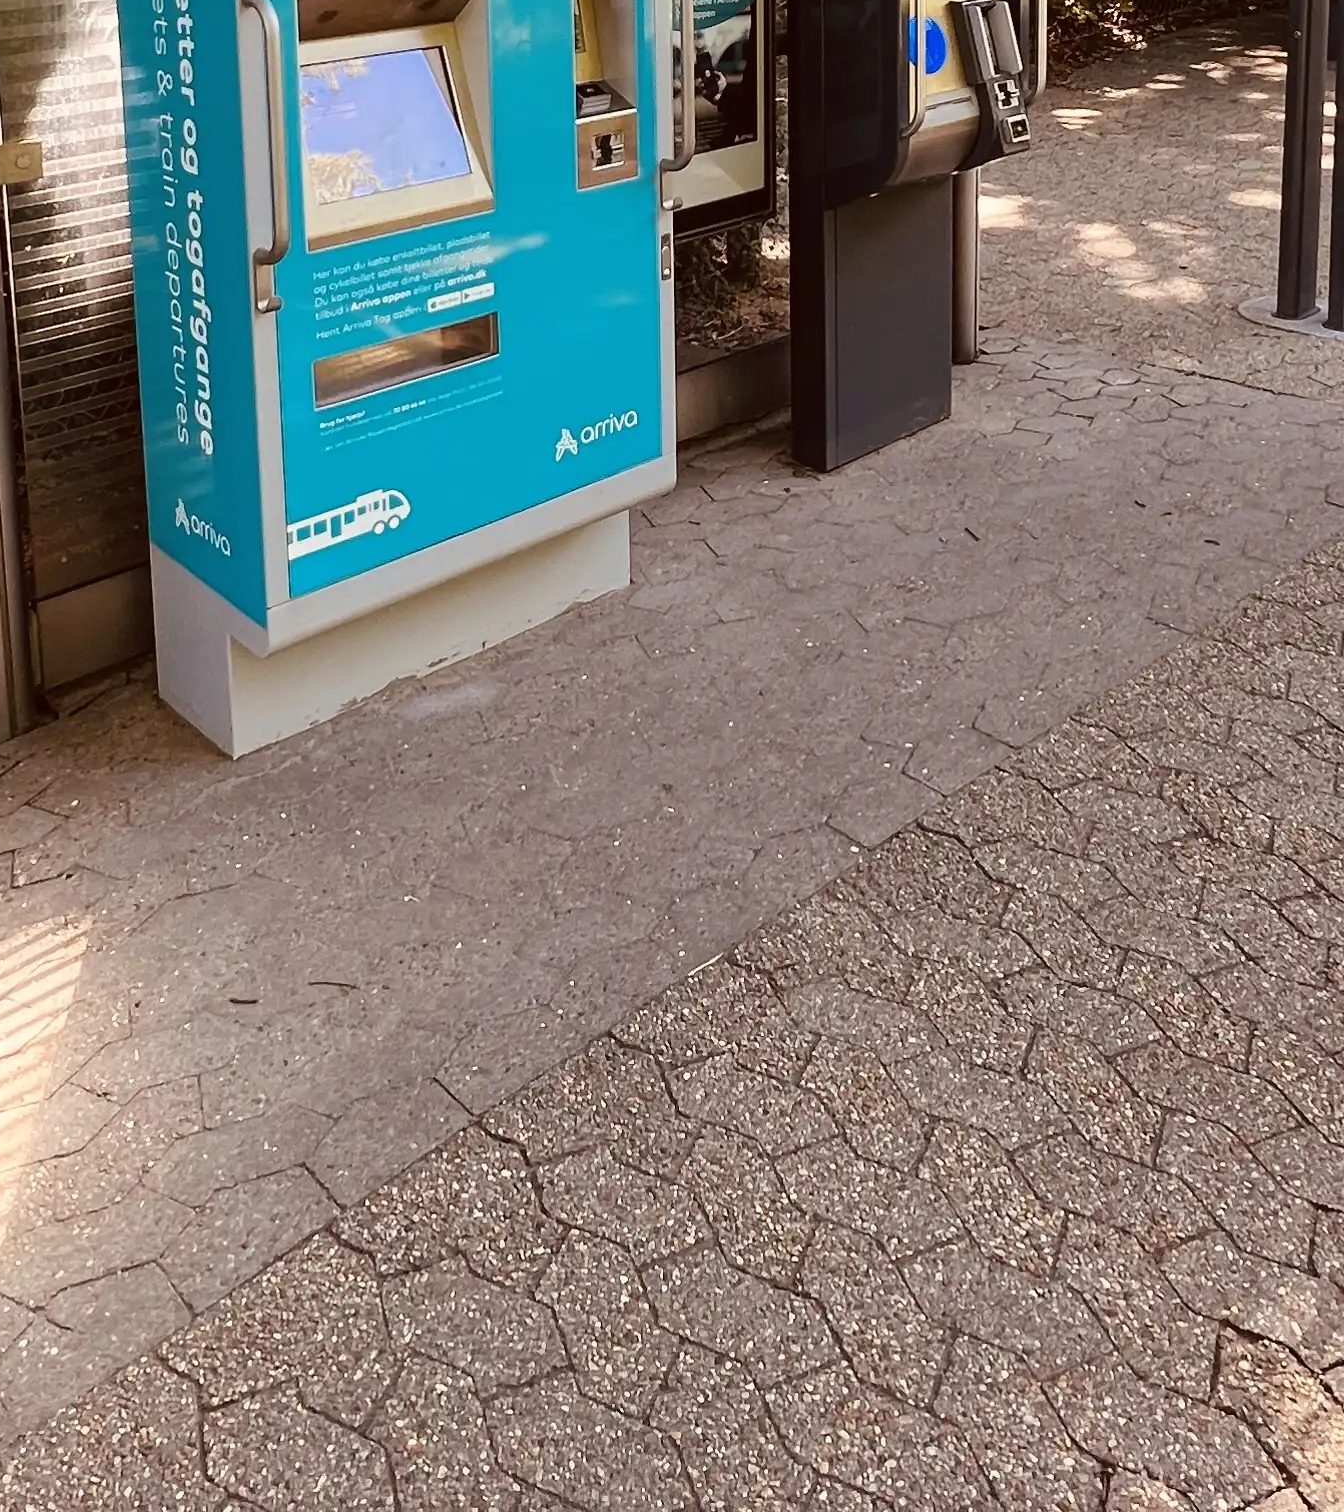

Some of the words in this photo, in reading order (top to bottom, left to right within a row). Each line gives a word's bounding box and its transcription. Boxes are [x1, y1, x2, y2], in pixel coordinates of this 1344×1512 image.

[156, 69, 174, 97] &
[159, 112, 179, 207] train
[180, 118, 199, 175] og
[313, 270, 331, 280] Her
[333, 265, 351, 275] kan
[353, 261, 366, 271] du
[314, 285, 327, 296] og
[315, 305, 344, 320] tilbud
[351, 297, 381, 312] Arriva
[382, 290, 412, 304] appen
[434, 278, 446, 291] på
[447, 269, 487, 286] arriva.dk
[315, 297, 328, 308] Du
[331, 292, 349, 303] kan
[351, 284, 374, 299] også
[165, 222, 190, 446] departures
[186, 190, 214, 456] togafgange
[316, 327, 340, 339] Hent
[343, 319, 372, 333] Arriva
[581, 410, 637, 444] arriva
[191, 514, 231, 557] arriva
